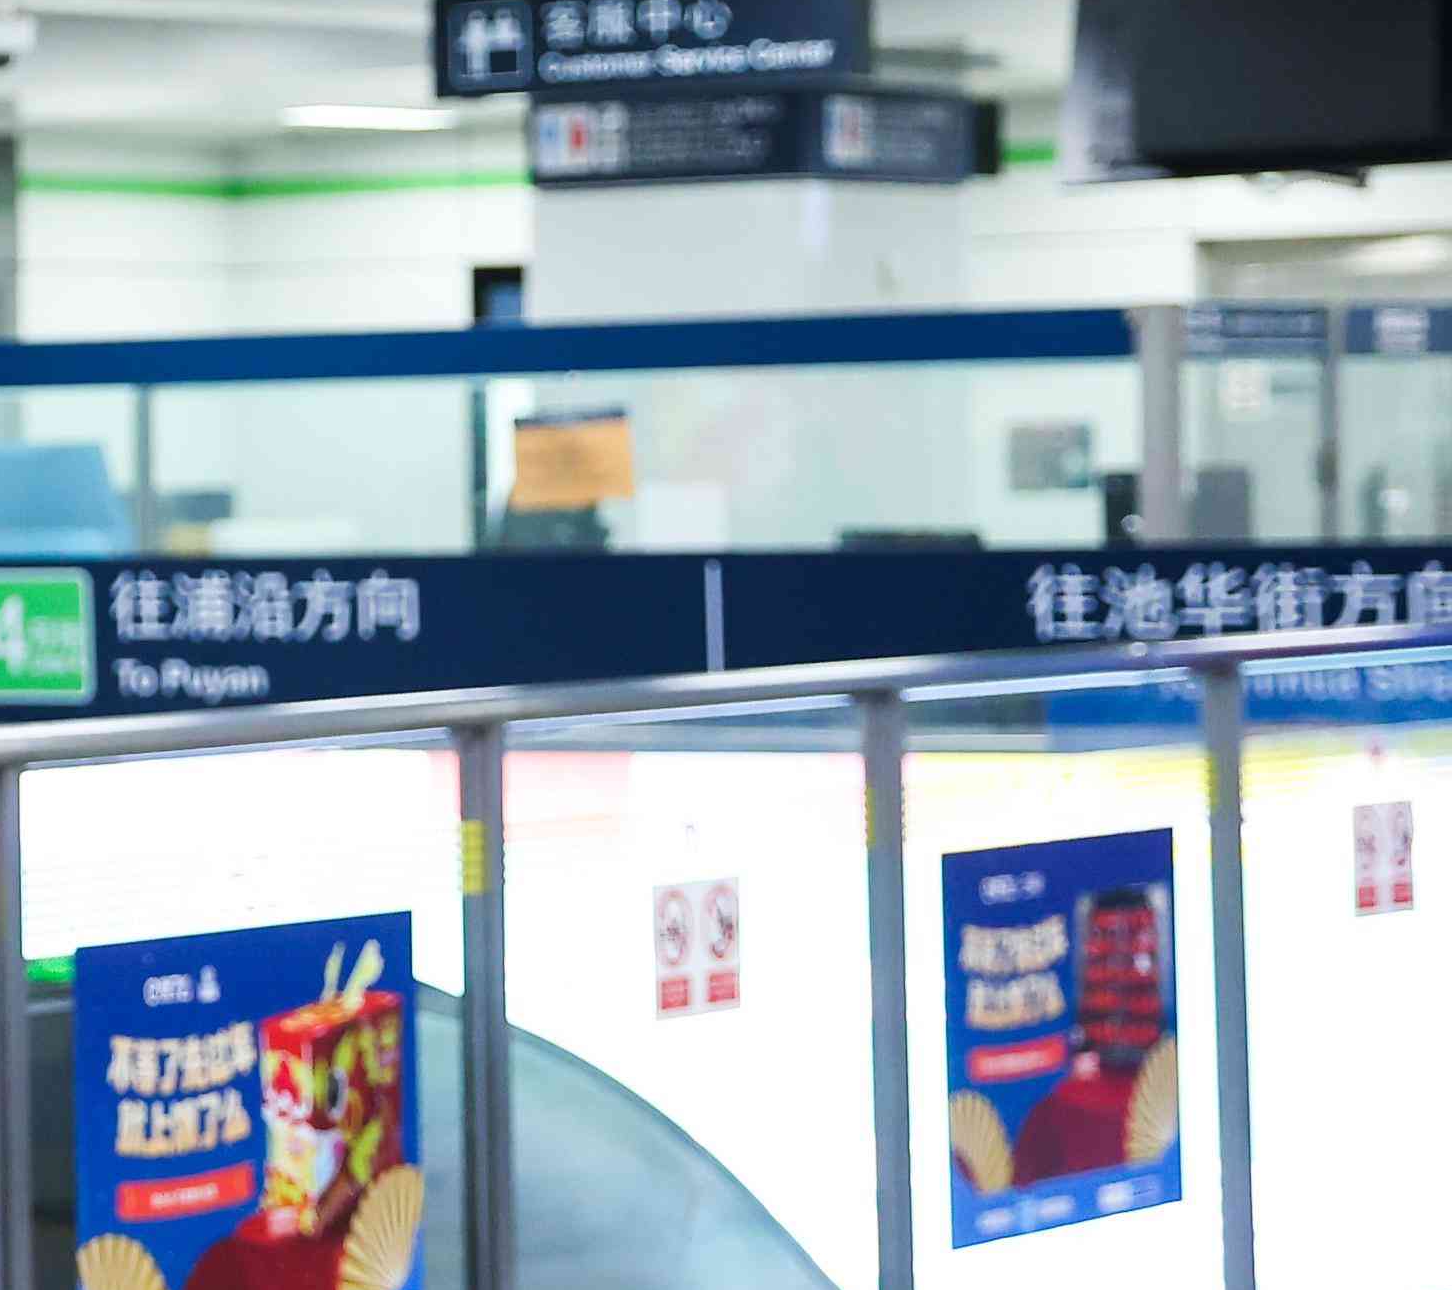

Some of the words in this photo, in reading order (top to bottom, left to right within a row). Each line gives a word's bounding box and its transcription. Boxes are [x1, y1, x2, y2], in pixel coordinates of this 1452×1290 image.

[110, 568, 420, 642] 往浦沿方向
[113, 658, 159, 698] To
